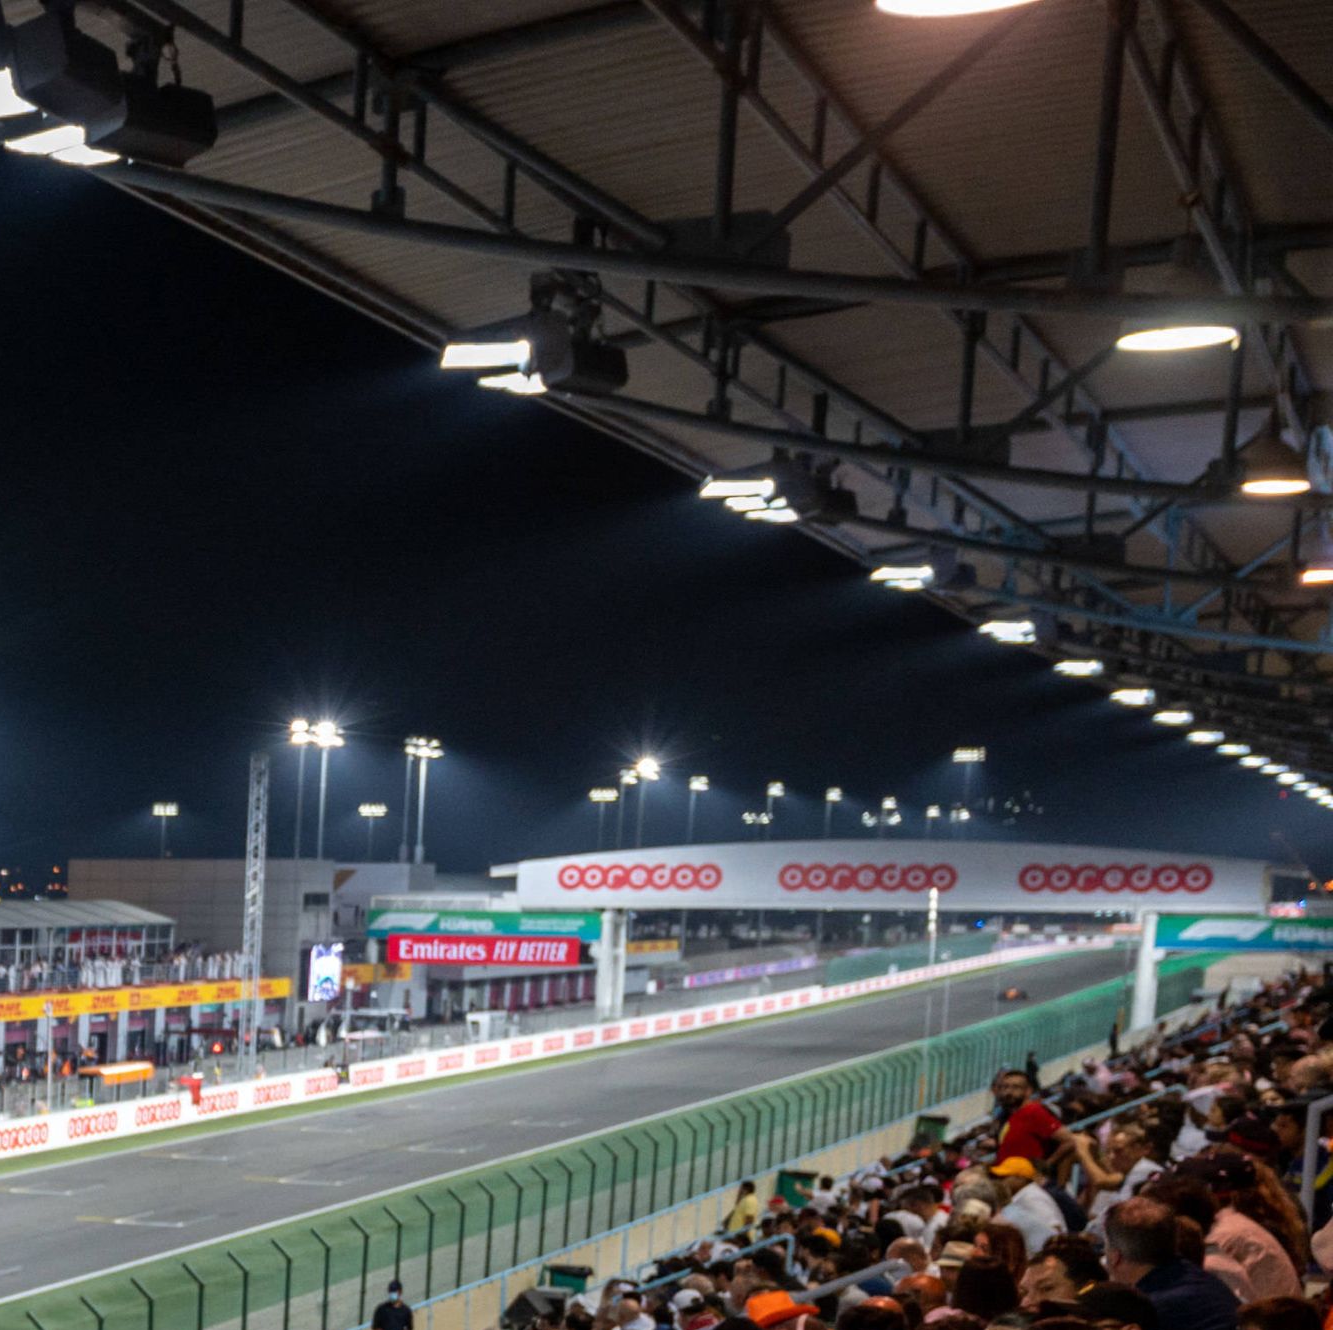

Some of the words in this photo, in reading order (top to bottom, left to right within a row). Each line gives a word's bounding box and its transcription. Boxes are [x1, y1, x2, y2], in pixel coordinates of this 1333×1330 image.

[558, 864, 723, 891] ooredoo
[779, 864, 957, 892] ooredoo
[1018, 864, 1213, 894] ooredoo
[399, 939, 486, 961] Emirates
[493, 941, 515, 961] FLY
[519, 941, 568, 962] BETTER
